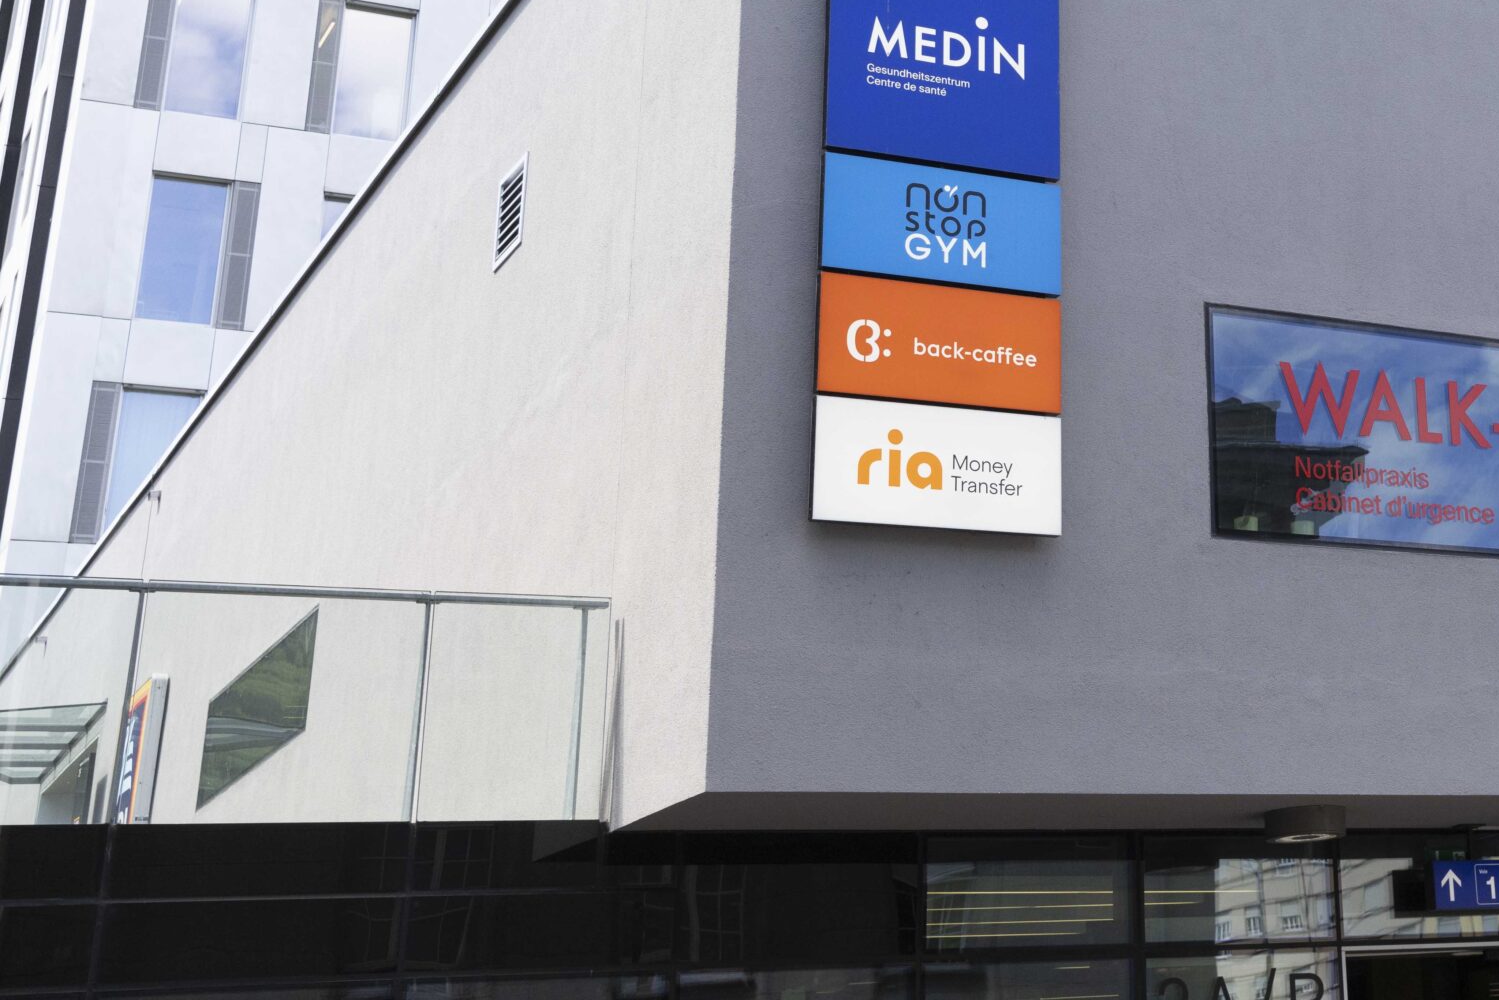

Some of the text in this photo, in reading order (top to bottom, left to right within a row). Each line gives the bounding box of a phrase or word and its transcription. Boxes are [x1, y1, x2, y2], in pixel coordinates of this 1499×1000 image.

[867, 15, 1026, 80] MEDIN
[866, 63, 971, 89] Gesundheitszentrum
[866, 74, 948, 98] Centre de santé
[904, 210, 987, 239] stop
[904, 232, 987, 268] GYM
[913, 337, 1037, 368] back-caffee
[857, 428, 943, 491] ria
[952, 453, 1013, 479] Money
[1294, 456, 1430, 490] Notfallpraxis
[951, 475, 1023, 498] Transfer
[1295, 486, 1382, 516] Cabinet
[1486, 876, 1496, 899] 1
